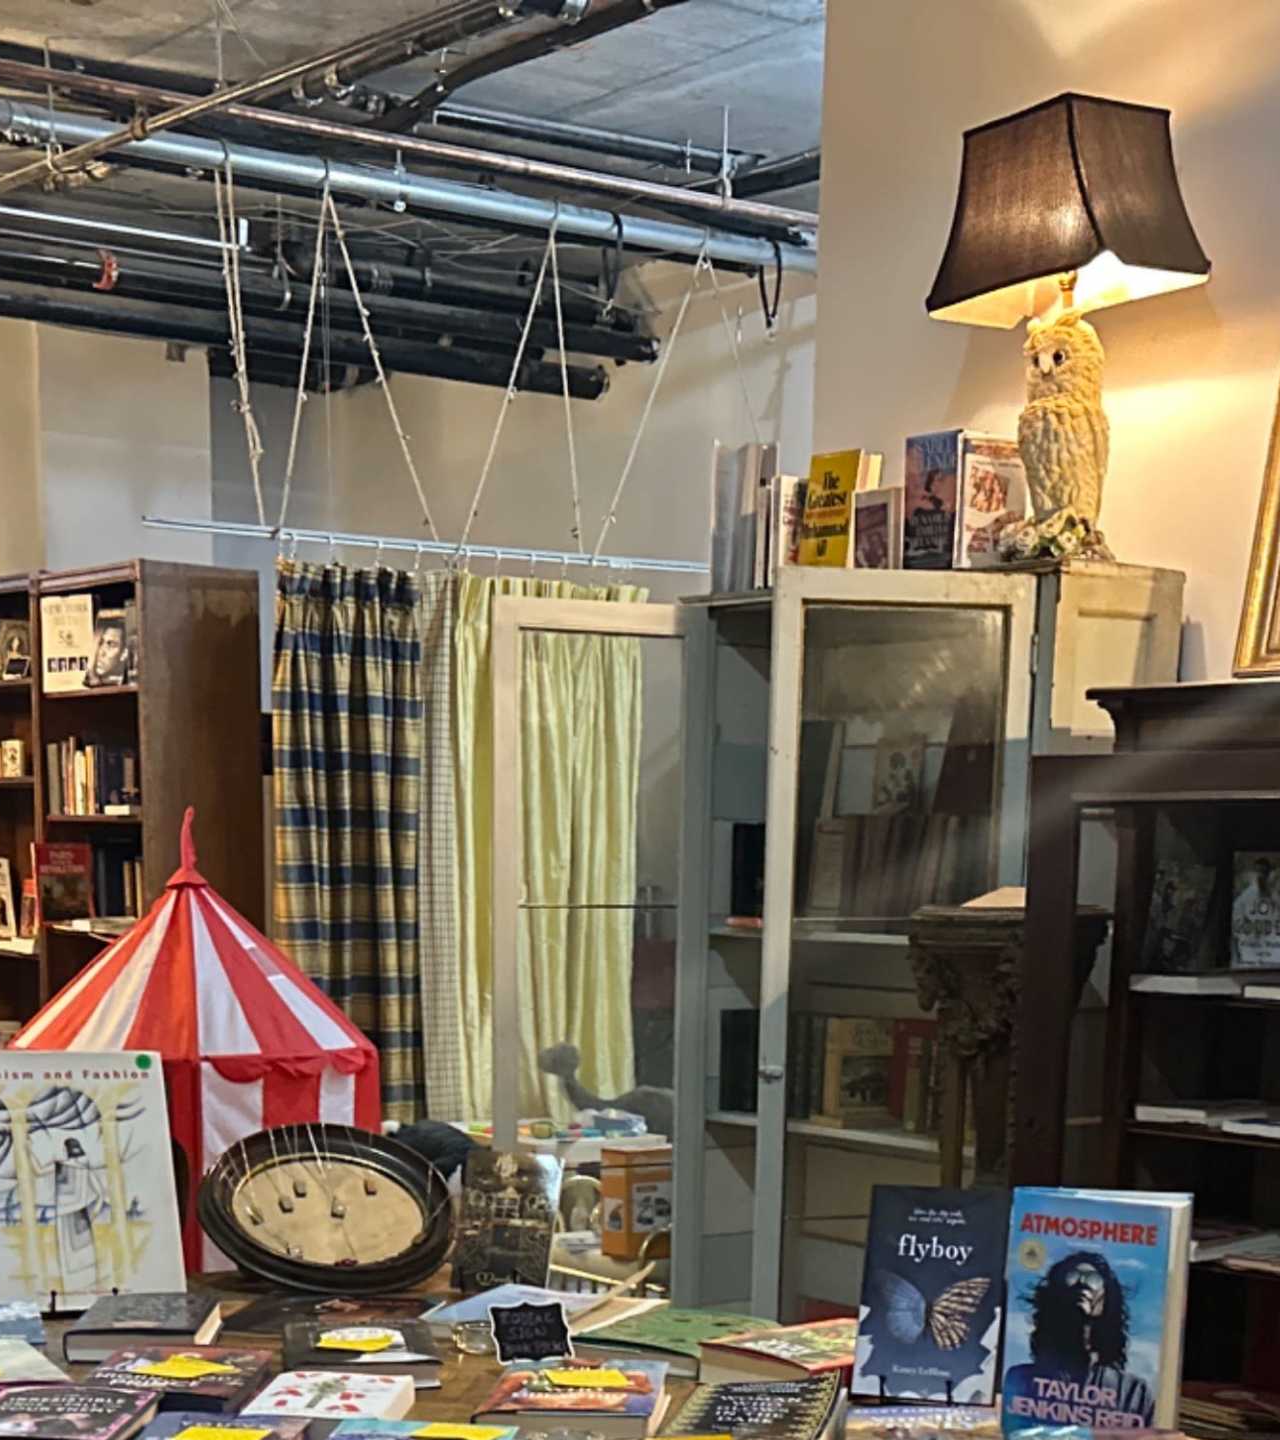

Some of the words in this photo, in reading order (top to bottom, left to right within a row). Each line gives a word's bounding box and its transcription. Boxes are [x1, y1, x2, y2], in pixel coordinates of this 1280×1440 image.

[43, 1070, 73, 1080] and
[83, 1069, 150, 1080] Fashion
[1021, 1213, 1159, 1247] ATMOSPHERE
[898, 1233, 973, 1266] flyboy
[1034, 1377, 1118, 1408] TAYLOR
[1006, 1397, 1094, 1427] JENKINS
[1095, 1408, 1145, 1429] REID
